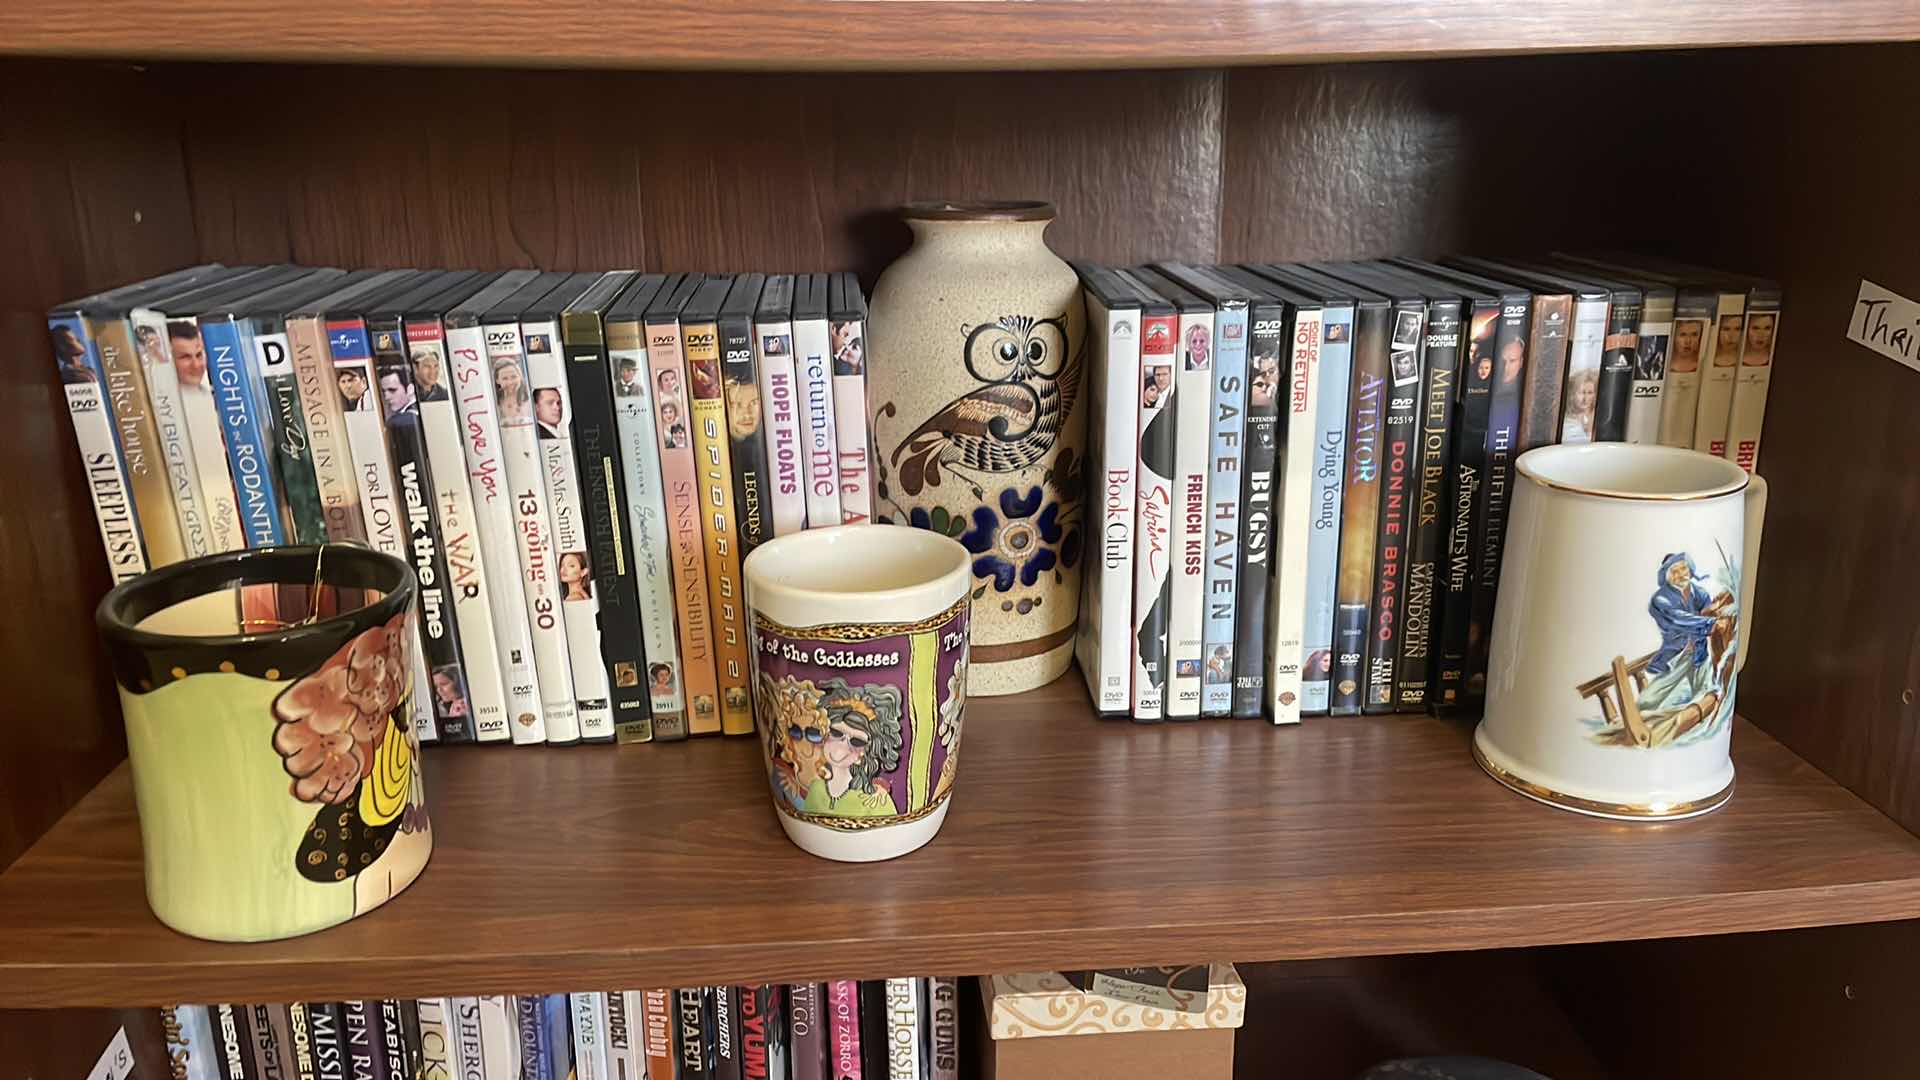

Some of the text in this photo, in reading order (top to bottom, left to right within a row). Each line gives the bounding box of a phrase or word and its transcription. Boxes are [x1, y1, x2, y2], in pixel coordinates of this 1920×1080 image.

[687, 335, 714, 347] DVD
[1253, 321, 1282, 334] DVD
[1309, 320, 1320, 348] POINT
[1427, 334, 1458, 342] DOUBLE
[1503, 306, 1526, 317] DVD
[214, 345, 248, 427] NIGHTS
[726, 349, 750, 363] DVD
[1292, 321, 1309, 414] NO RETURN
[296, 344, 330, 441] MESSAGE
[1216, 376, 1241, 473] SAFE
[1391, 398, 1414, 409] DVD
[1634, 386, 1660, 398] DVD
[771, 373, 797, 496] HOPE FLOATS
[807, 353, 835, 497] return to me
[1420, 368, 1452, 528] MEET JOE BLACK
[1494, 426, 1510, 461] THE
[316, 448, 333, 469] IN
[323, 476, 336, 488] A
[839, 447, 867, 494] The
[1315, 430, 1342, 531] Dying Young
[1489, 465, 1506, 513] FIFTH
[87, 452, 139, 565] SLEEPLESS
[364, 462, 397, 552] FOR LOVE
[517, 489, 538, 518] 13
[556, 506, 577, 551] Smith
[743, 471, 761, 536] LEGENDS
[1105, 467, 1129, 570] Book Club
[1184, 474, 1203, 577] FRENCH KISS
[1247, 471, 1272, 569] BUGSY
[400, 461, 444, 640] walk the line
[446, 532, 480, 604] WAR
[518, 520, 548, 583] going
[673, 480, 707, 664] SENSE SENSIBILITY
[703, 417, 738, 646] SPIDER-MAN
[727, 659, 740, 678] 2
[1212, 501, 1237, 621] HAVEN
[1378, 441, 1407, 641] DONNIE BRASCO
[1450, 556, 1470, 593] WIFE
[534, 598, 555, 630] 30
[1404, 563, 1426, 658] MANDOLIN
[766, 638, 781, 655] of
[783, 644, 809, 664] the
[813, 647, 900, 669] Goddesses
[1371, 657, 1382, 685] STAR
[1382, 657, 1393, 683] TRI
[218, 1003, 245, 1080] NESOME
[382, 999, 402, 1080] EABISC
[418, 1001, 448, 1080] LICK
[645, 1015, 671, 1059] Cowboy
[742, 992, 766, 1080] TO YUM
[838, 1004, 850, 1022] OF
[895, 1008, 916, 1080] HORSE
[936, 1007, 956, 1072] GUNS
[839, 1025, 853, 1072] ZORRO
